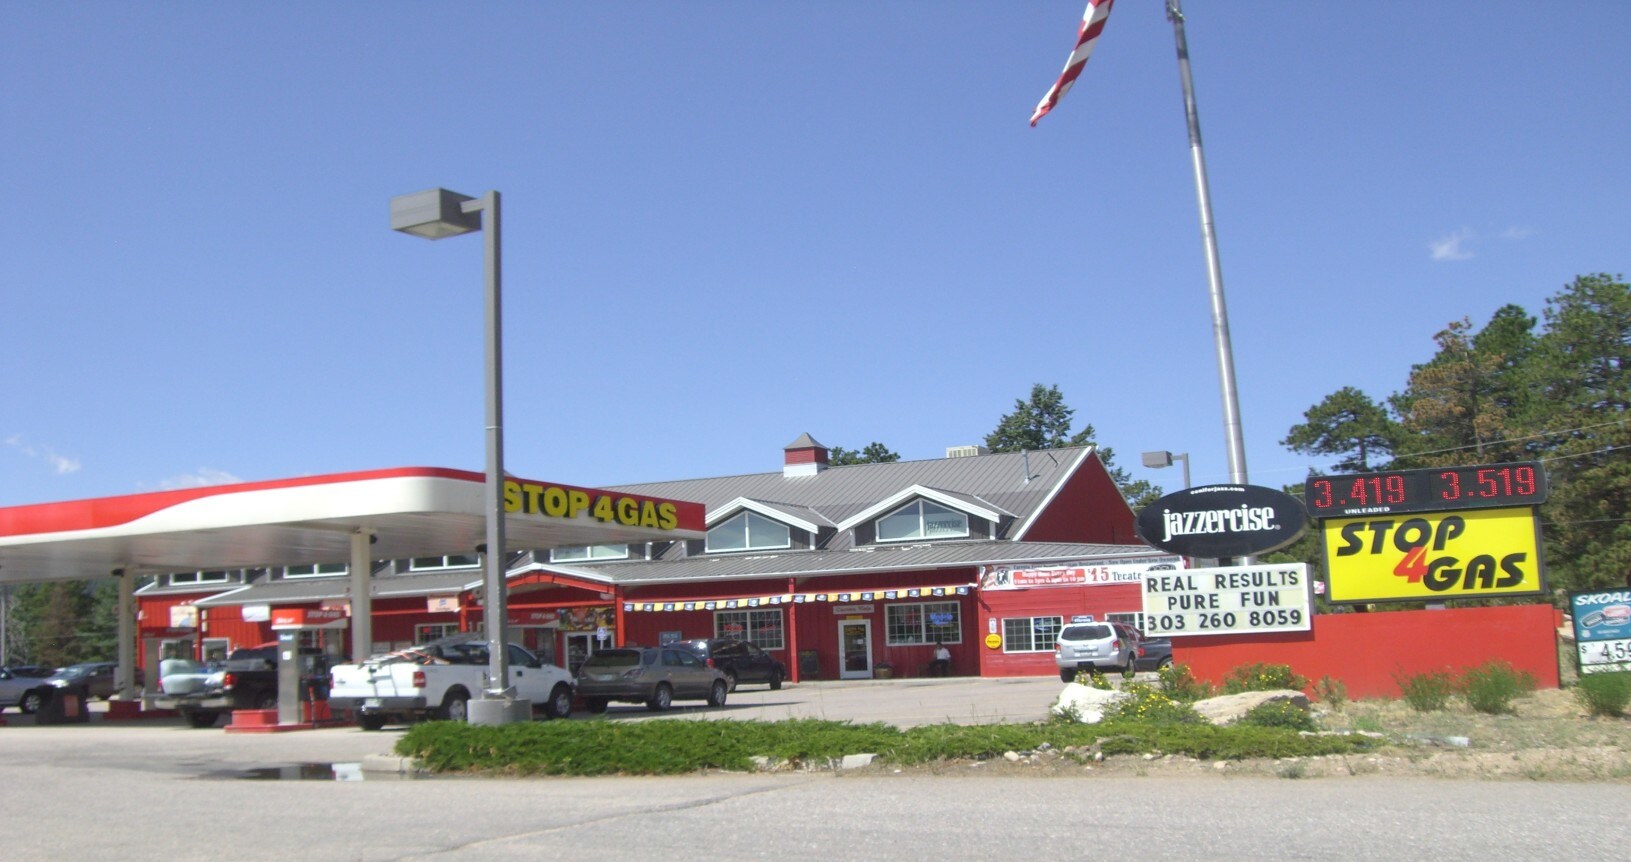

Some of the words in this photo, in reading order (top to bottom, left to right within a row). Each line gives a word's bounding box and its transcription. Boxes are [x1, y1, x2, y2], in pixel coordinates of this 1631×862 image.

[1314, 475, 1406, 508] 3.419
[1441, 466, 1536, 500] 3.519
[503, 480, 590, 518] STOP
[593, 495, 614, 523] 4
[617, 497, 678, 531] GAS
[1344, 506, 1390, 515] UNLEADED
[1162, 503, 1275, 542] jazzercise
[1336, 515, 1466, 557] STOP
[1393, 546, 1430, 584] 4
[1422, 552, 1527, 591] GAS
[1147, 575, 1197, 593] REAL
[1215, 571, 1298, 589] RESULTS
[1168, 593, 1220, 610] PURE
[1240, 590, 1280, 607] FUN
[1575, 591, 1631, 606] SKOAL
[1148, 614, 1185, 631] 303
[1198, 612, 1236, 629] 260
[1250, 609, 1301, 626] 8059
[1580, 645, 1587, 654] $
